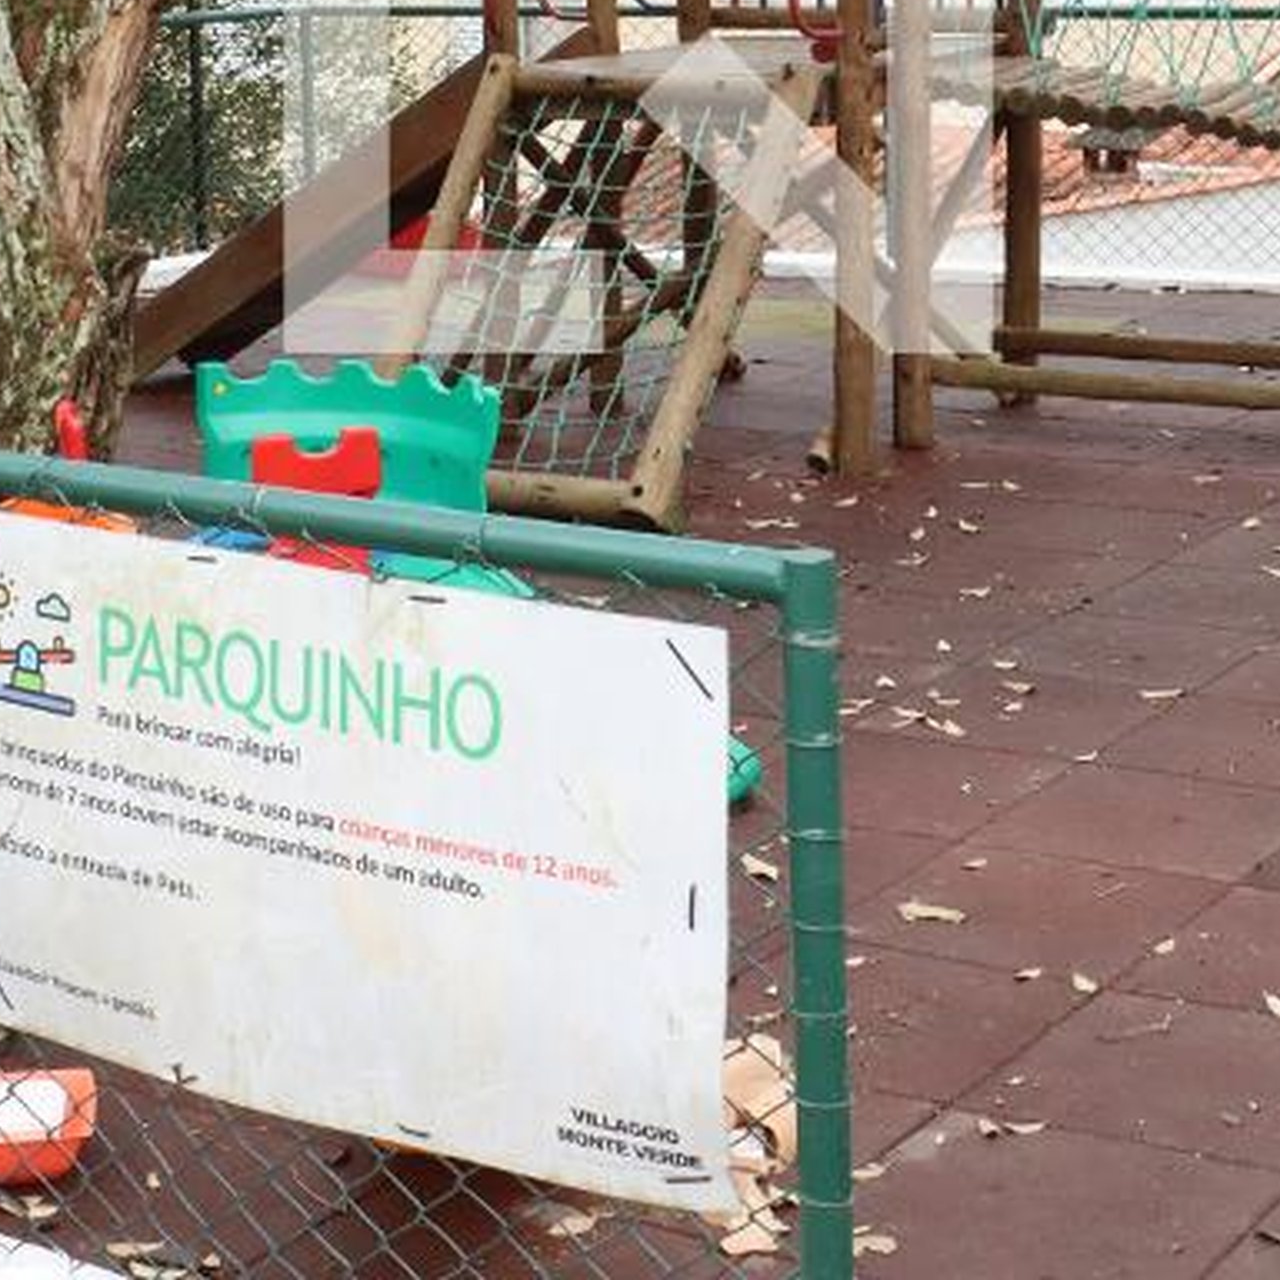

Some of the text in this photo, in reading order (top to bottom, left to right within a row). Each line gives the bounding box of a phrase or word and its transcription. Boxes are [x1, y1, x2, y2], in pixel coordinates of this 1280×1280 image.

[97, 605, 502, 761] PARQUINHO
[97, 706, 131, 730] Para
[136, 713, 193, 741] brincar
[197, 731, 234, 752] com
[80, 795, 117, 816] anos
[356, 854, 379, 877] de
[383, 865, 415, 885] um
[89, 759, 111, 781] do
[200, 786, 229, 809] são
[233, 791, 256, 814] de
[260, 800, 292, 822] uso
[296, 808, 335, 832] para
[339, 818, 412, 850] crianças
[416, 832, 498, 867] menores
[502, 850, 527, 871] de
[533, 854, 558, 878] 12
[557, 1126, 704, 1169] MONTE VERDE
[570, 1107, 680, 1145] VILLAGGIO
